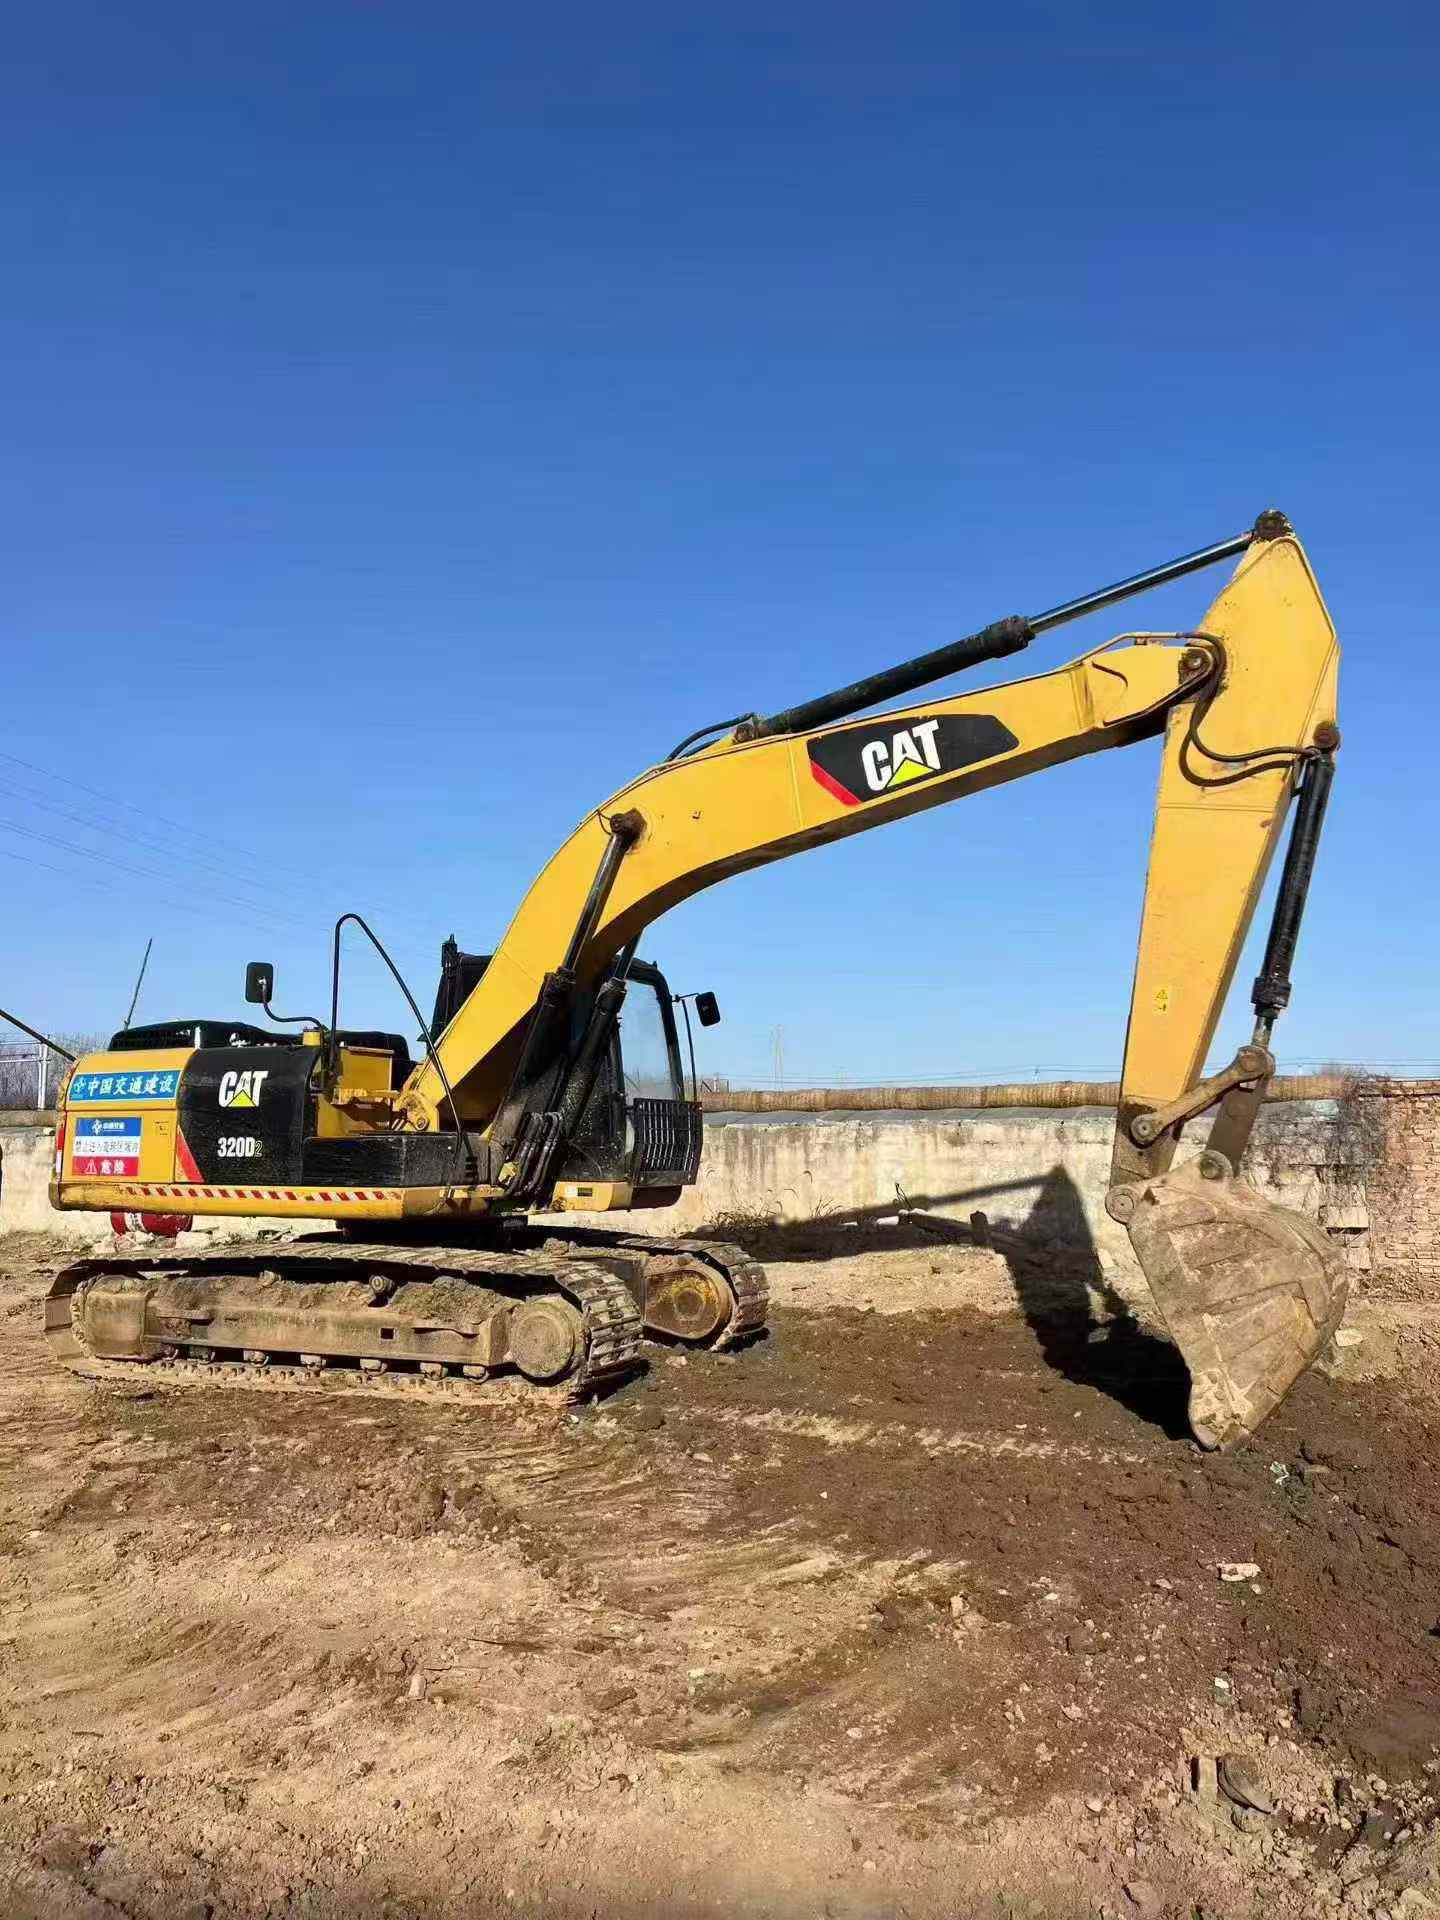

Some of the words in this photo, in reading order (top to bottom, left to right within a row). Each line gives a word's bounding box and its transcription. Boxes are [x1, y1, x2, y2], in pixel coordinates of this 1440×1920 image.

[861, 719, 941, 791] CAT
[87, 1075, 174, 1096] 中国交通建设
[218, 1070, 269, 1108] CAT
